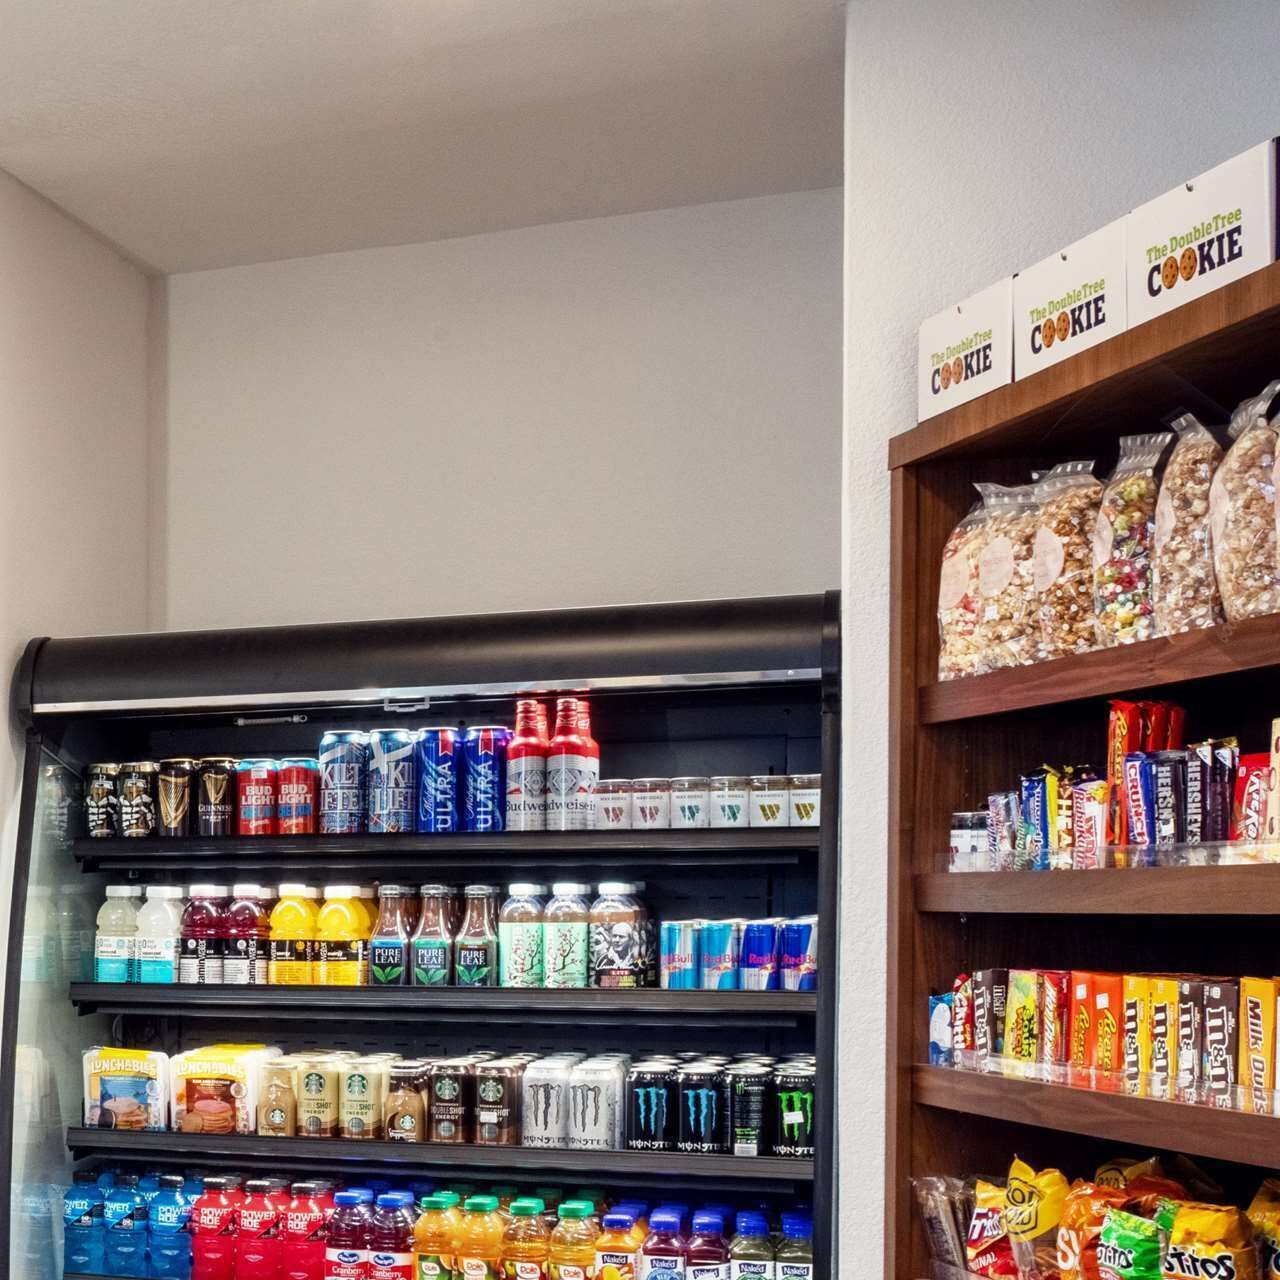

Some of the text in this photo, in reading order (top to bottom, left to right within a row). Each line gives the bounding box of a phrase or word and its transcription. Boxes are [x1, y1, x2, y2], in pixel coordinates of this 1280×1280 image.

[1146, 208, 1242, 264] The DoubleTree
[1030, 277, 1105, 324] The DoubleTree
[931, 328, 992, 367] The DoubleTree
[246, 785, 272, 795] BUD
[282, 784, 308, 794] BUD
[241, 795, 275, 805] LIGHT
[278, 794, 312, 804] LIGHT
[436, 761, 452, 831] ULTRA
[477, 761, 493, 831] ULTRA
[375, 948, 401, 956] PURE
[418, 949, 444, 958] PURE
[461, 950, 485, 959] PURE
[375, 955, 401, 963] LEAF
[418, 956, 444, 965] LEAF
[461, 957, 485, 965] LEAF
[1247, 997, 1264, 1049] Milk
[240, 1210, 276, 1221] POWER
[604, 1255, 627, 1264] Naked
[653, 1260, 676, 1268] Naked
[741, 1264, 765, 1273] Naked
[784, 1267, 808, 1275] Naked
